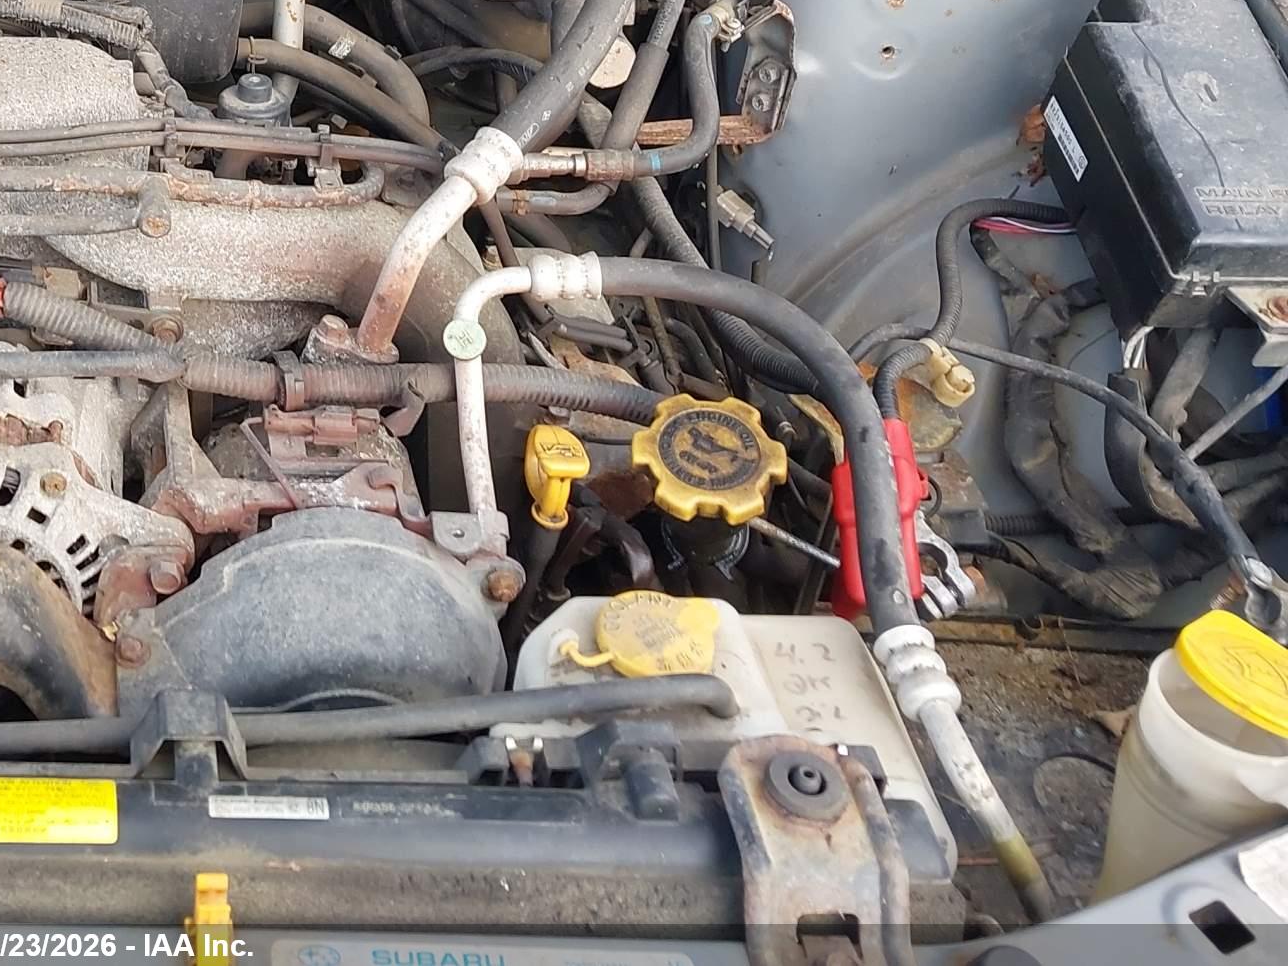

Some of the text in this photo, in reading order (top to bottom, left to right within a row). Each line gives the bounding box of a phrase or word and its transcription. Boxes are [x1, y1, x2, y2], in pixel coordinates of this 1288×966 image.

[1195, 187, 1263, 199] MAIN
[1204, 203, 1281, 216] RELAY
[371, 948, 505, 966] SUBARU
